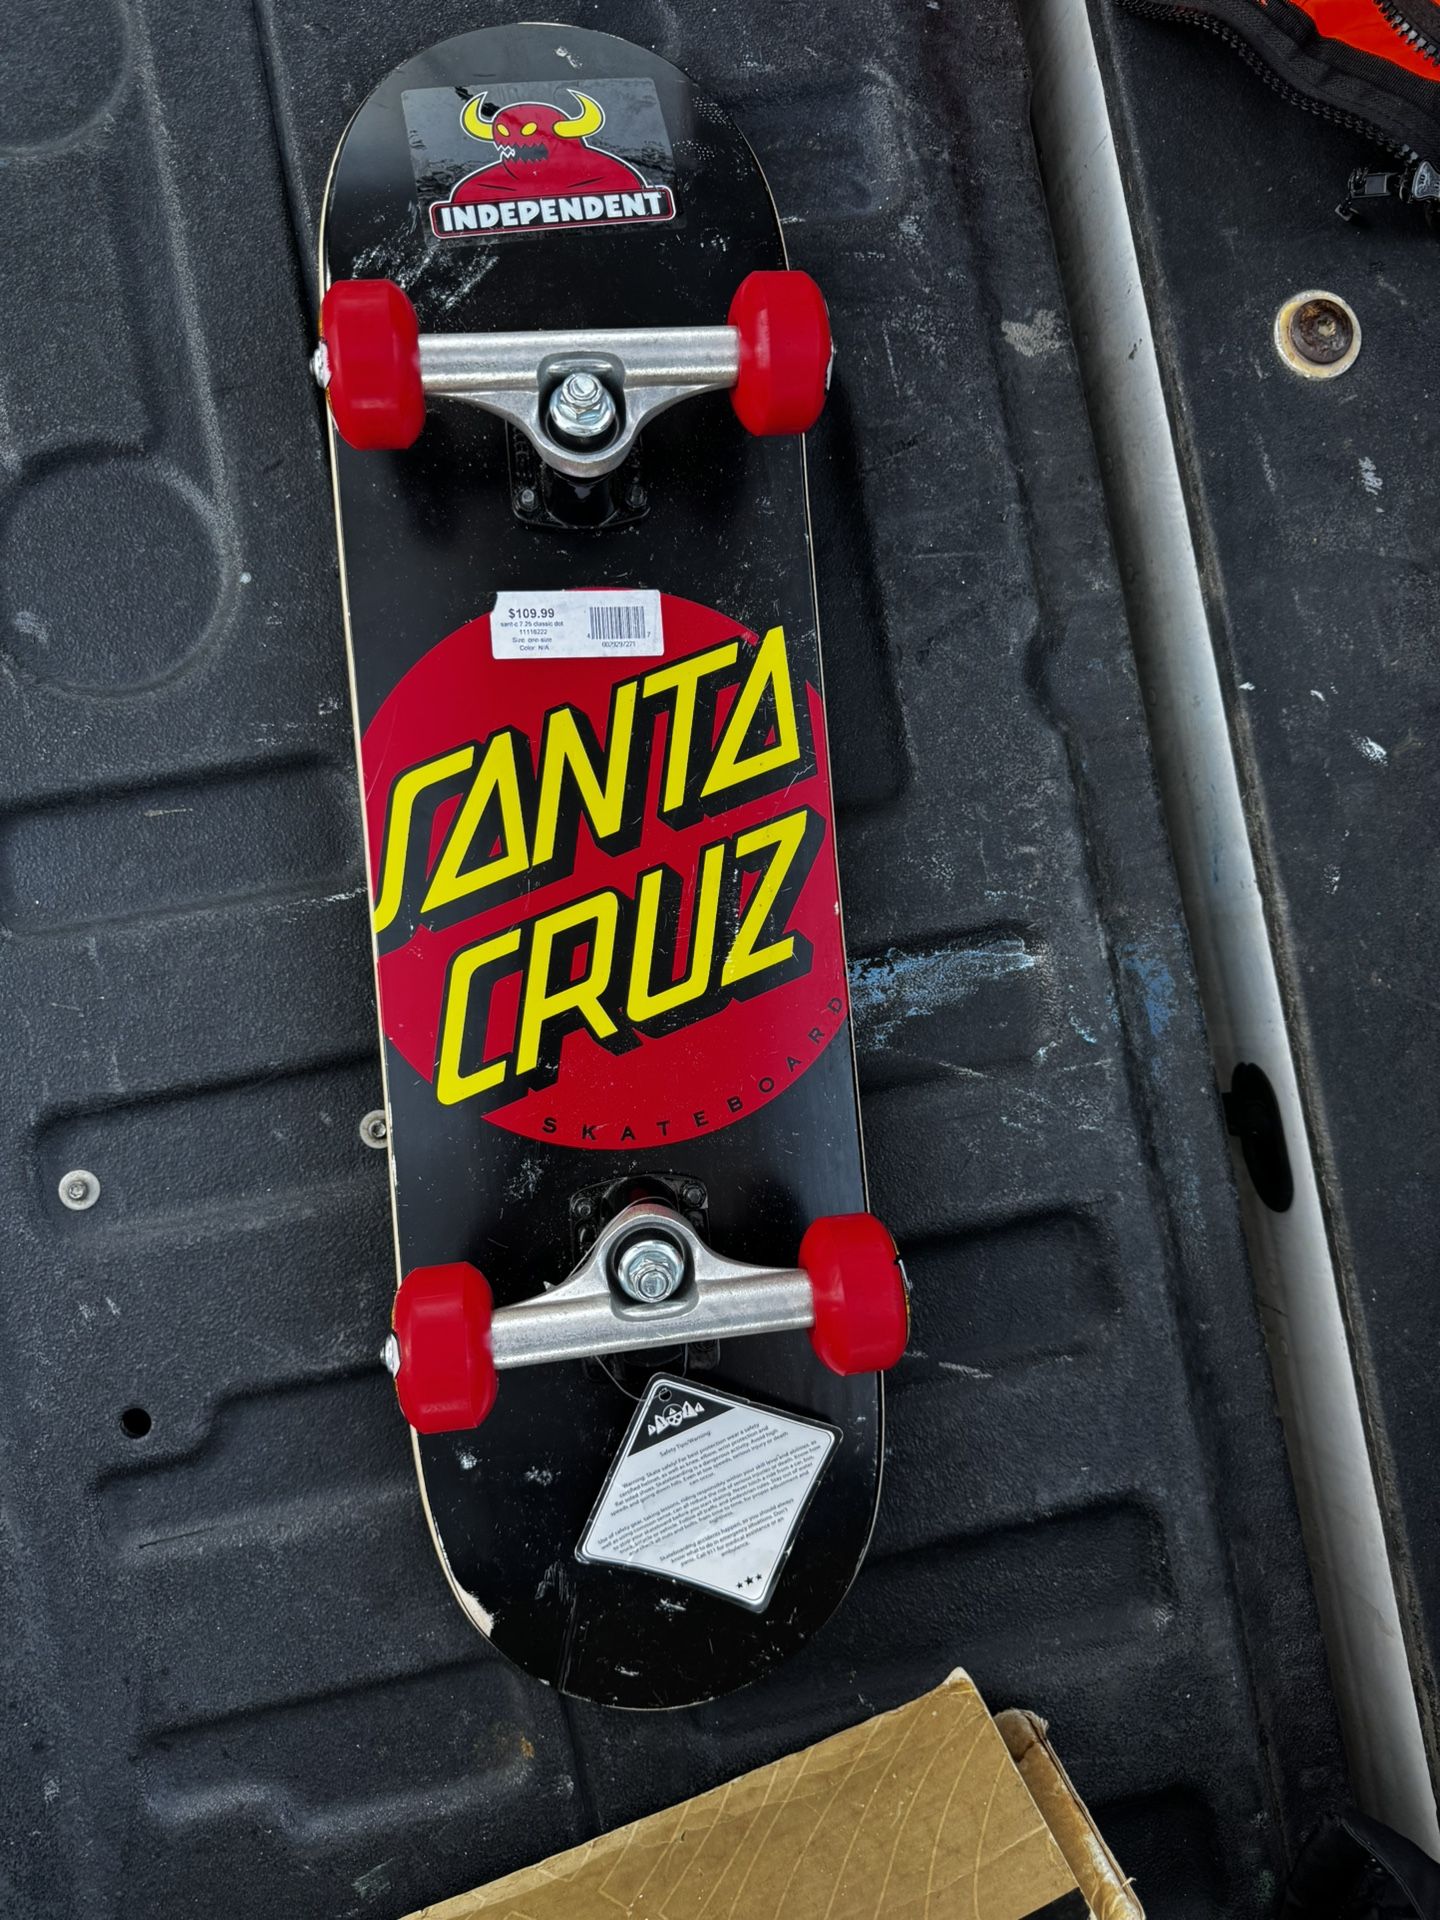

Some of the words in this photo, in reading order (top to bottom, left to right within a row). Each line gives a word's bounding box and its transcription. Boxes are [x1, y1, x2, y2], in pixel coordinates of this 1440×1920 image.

[441, 191, 662, 231] INDEPENDENT
[508, 608, 555, 619] $109.99
[374, 626, 800, 933] SANTA
[437, 810, 807, 1106] CRUZ
[542, 997, 844, 1141] SKATEBOARD
